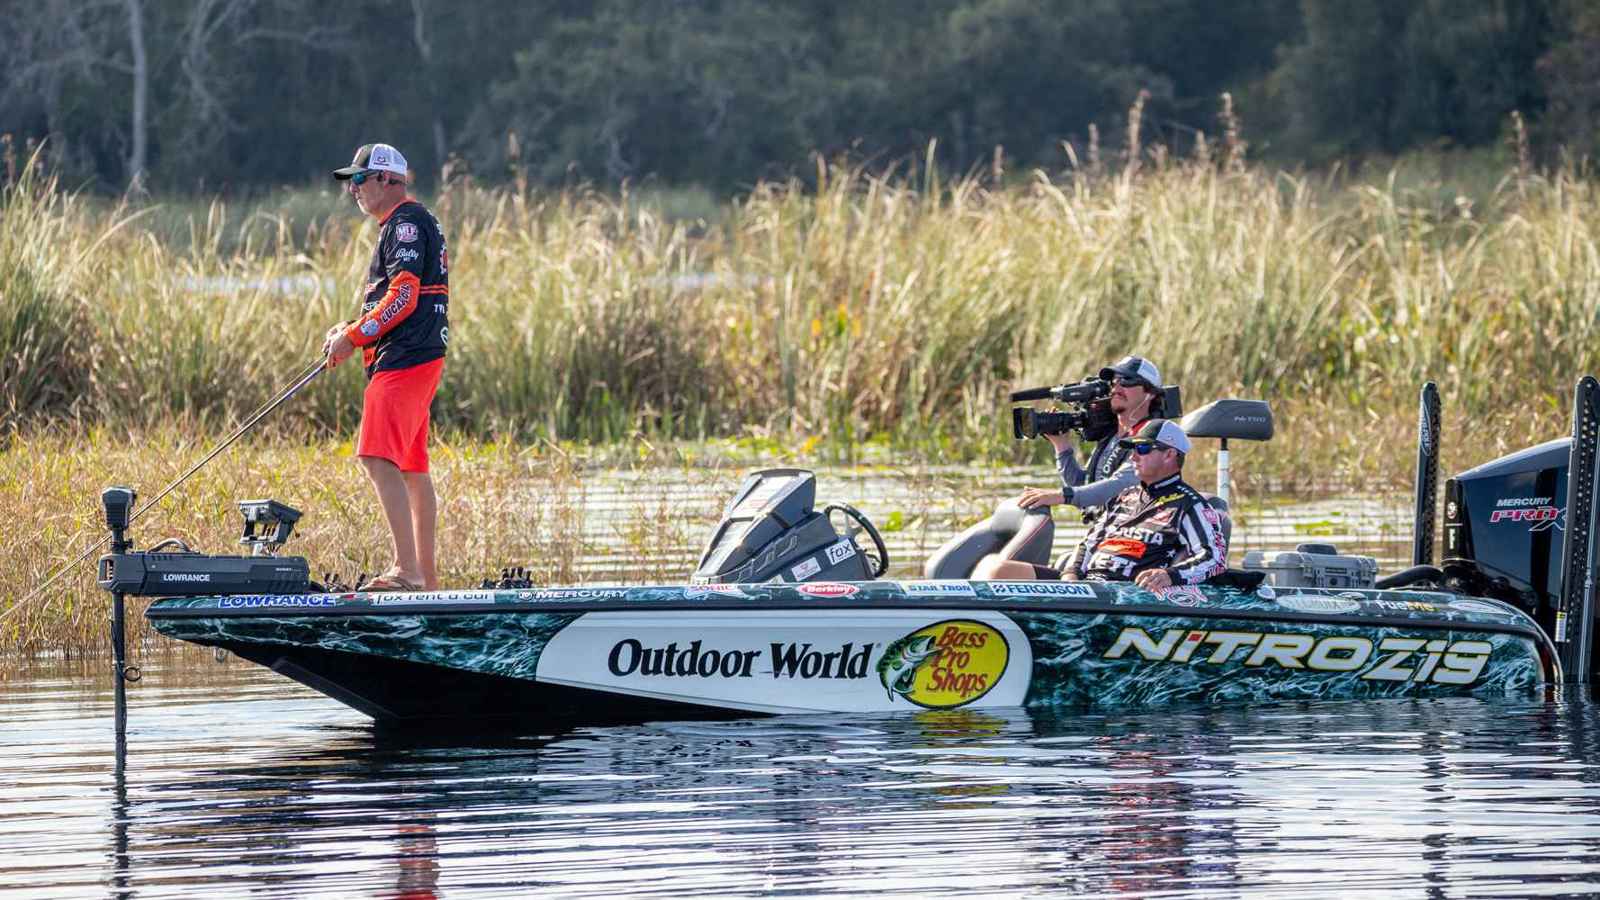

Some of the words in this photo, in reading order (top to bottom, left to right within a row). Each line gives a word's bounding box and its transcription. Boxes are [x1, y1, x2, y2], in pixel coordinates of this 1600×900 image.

[1496, 497, 1552, 507] MERCURY
[830, 543, 851, 563] fox
[163, 573, 210, 583] LOWRANCE
[536, 590, 629, 600] MERCURY
[1007, 583, 1090, 595] FERGUSON
[218, 595, 337, 609] LOWRANCE
[937, 627, 989, 648] Bass
[609, 638, 761, 678] Outdoor
[771, 642, 875, 680] World
[930, 647, 971, 669] Pro
[1362, 638, 1492, 685] Z19
[926, 667, 988, 699] Shops
